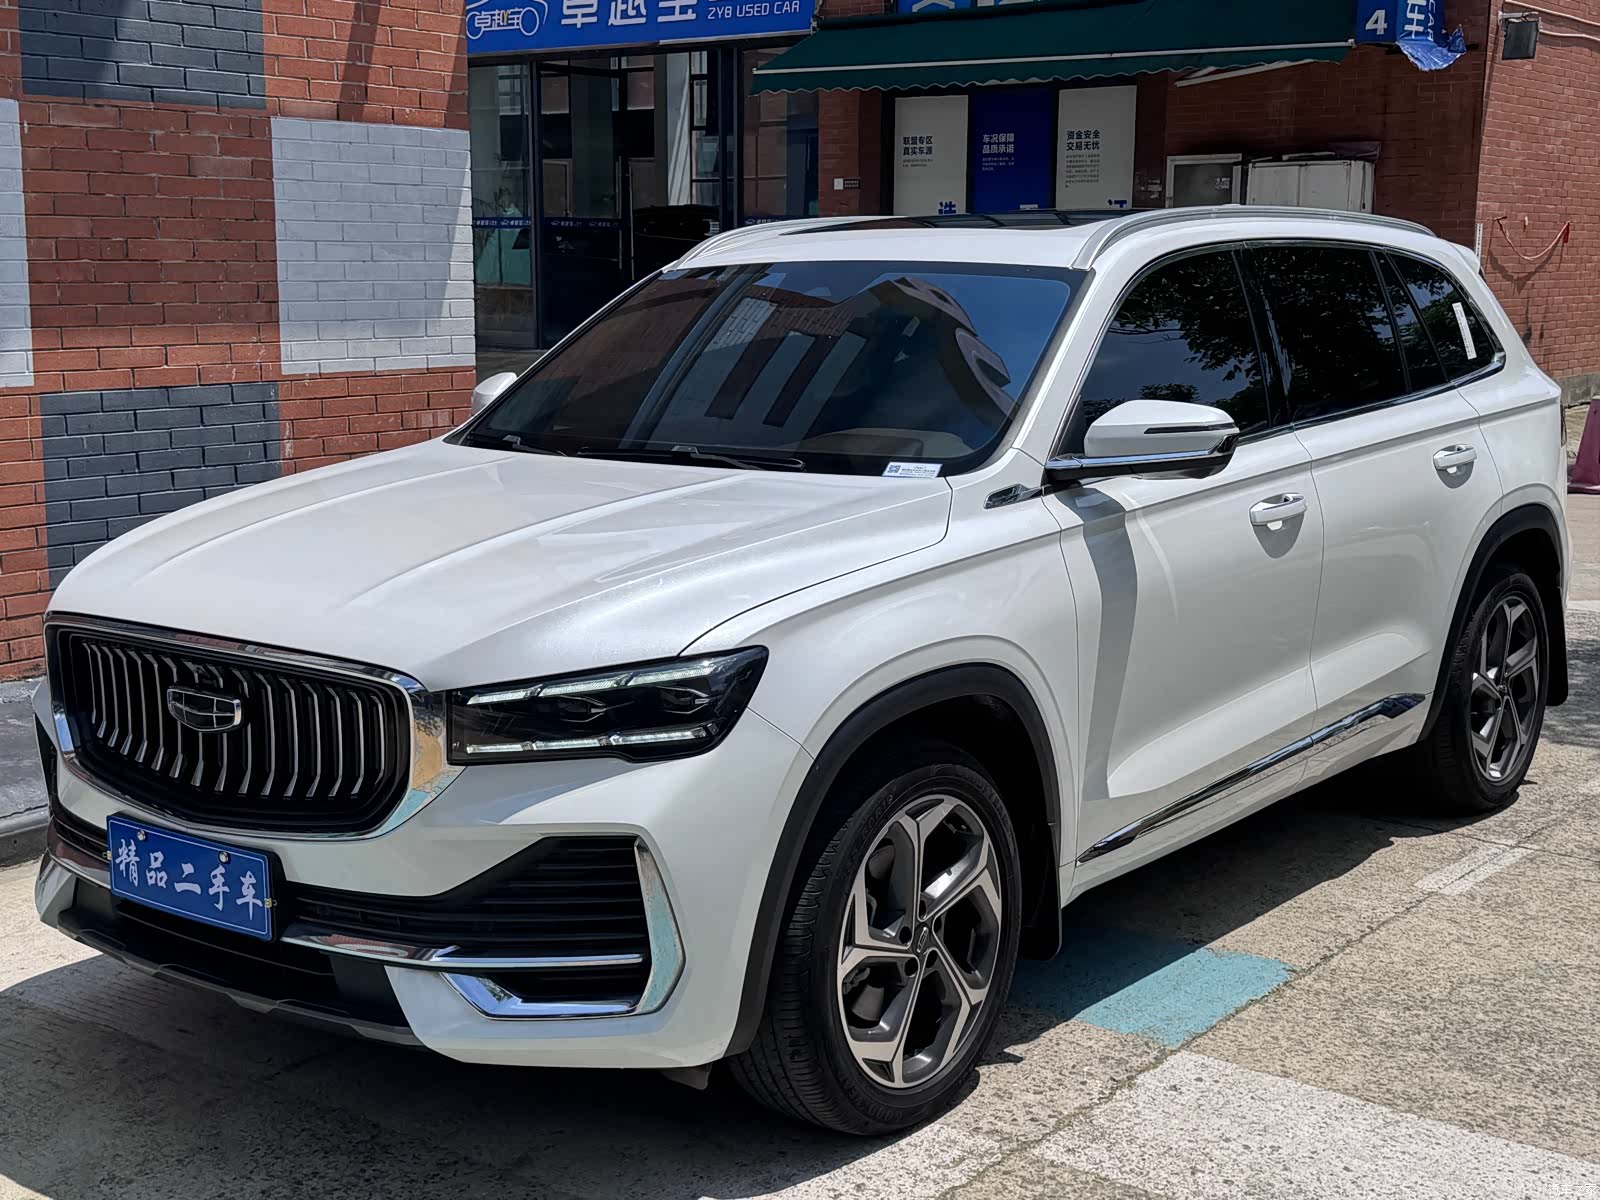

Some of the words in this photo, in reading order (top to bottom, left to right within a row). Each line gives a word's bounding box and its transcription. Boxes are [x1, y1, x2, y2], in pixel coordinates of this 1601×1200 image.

[736, 3, 769, 17] USED
[774, 1, 800, 15] CAR
[1365, 9, 1388, 35] 4
[982, 133, 1015, 143] 车况保障
[1066, 129, 1101, 140] 资金安全
[903, 136, 933, 145] 联盟专区
[903, 146, 933, 156] 真实车源
[982, 144, 1015, 154] 品质承诺
[1066, 141, 1101, 151] 交易无忧
[116, 839, 263, 921] 精品二手车
